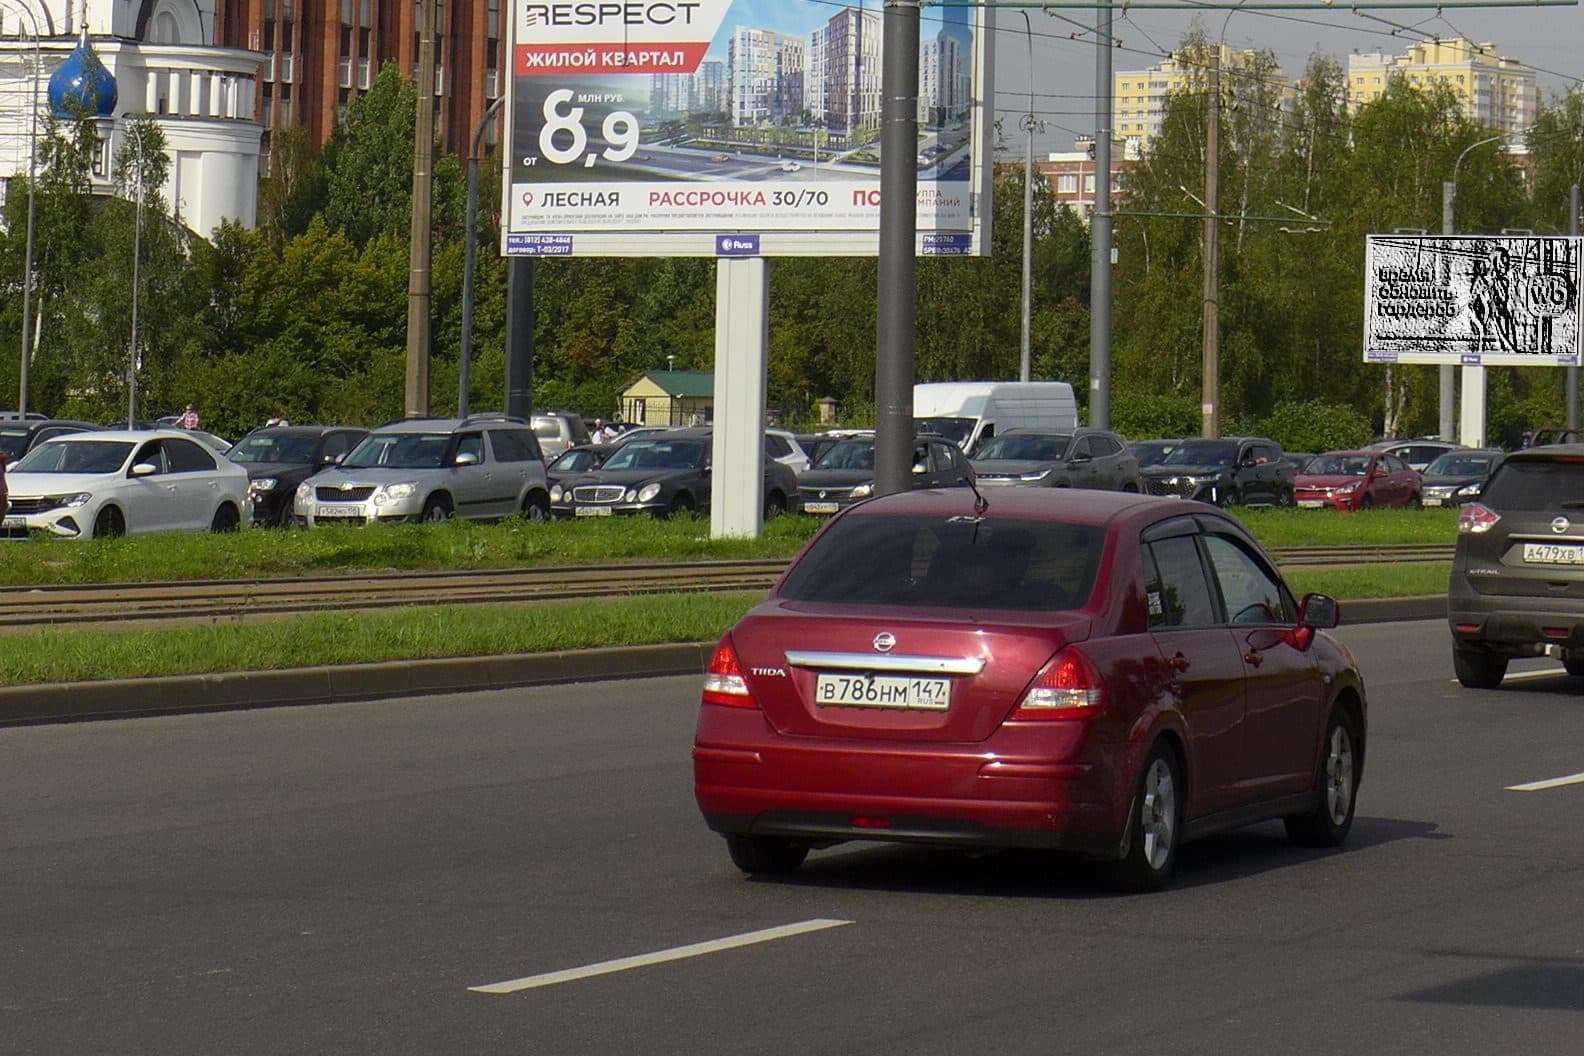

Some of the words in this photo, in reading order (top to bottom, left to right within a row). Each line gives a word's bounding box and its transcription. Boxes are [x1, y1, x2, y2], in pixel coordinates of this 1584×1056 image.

[526, 2, 701, 27] RESPECT
[526, 48, 596, 67] ЖИЛОЙ
[602, 51, 685, 66] КВАРТАЛ
[578, 94, 602, 103] МЛН
[541, 192, 620, 207] ЛЕСНАЯ
[649, 191, 767, 207] РАССРОЧКА
[772, 188, 829, 208] 30/70
[853, 190, 881, 206] ПС
[917, 197, 960, 208] МПАНИЙ
[752, 667, 786, 677] TIIDA
